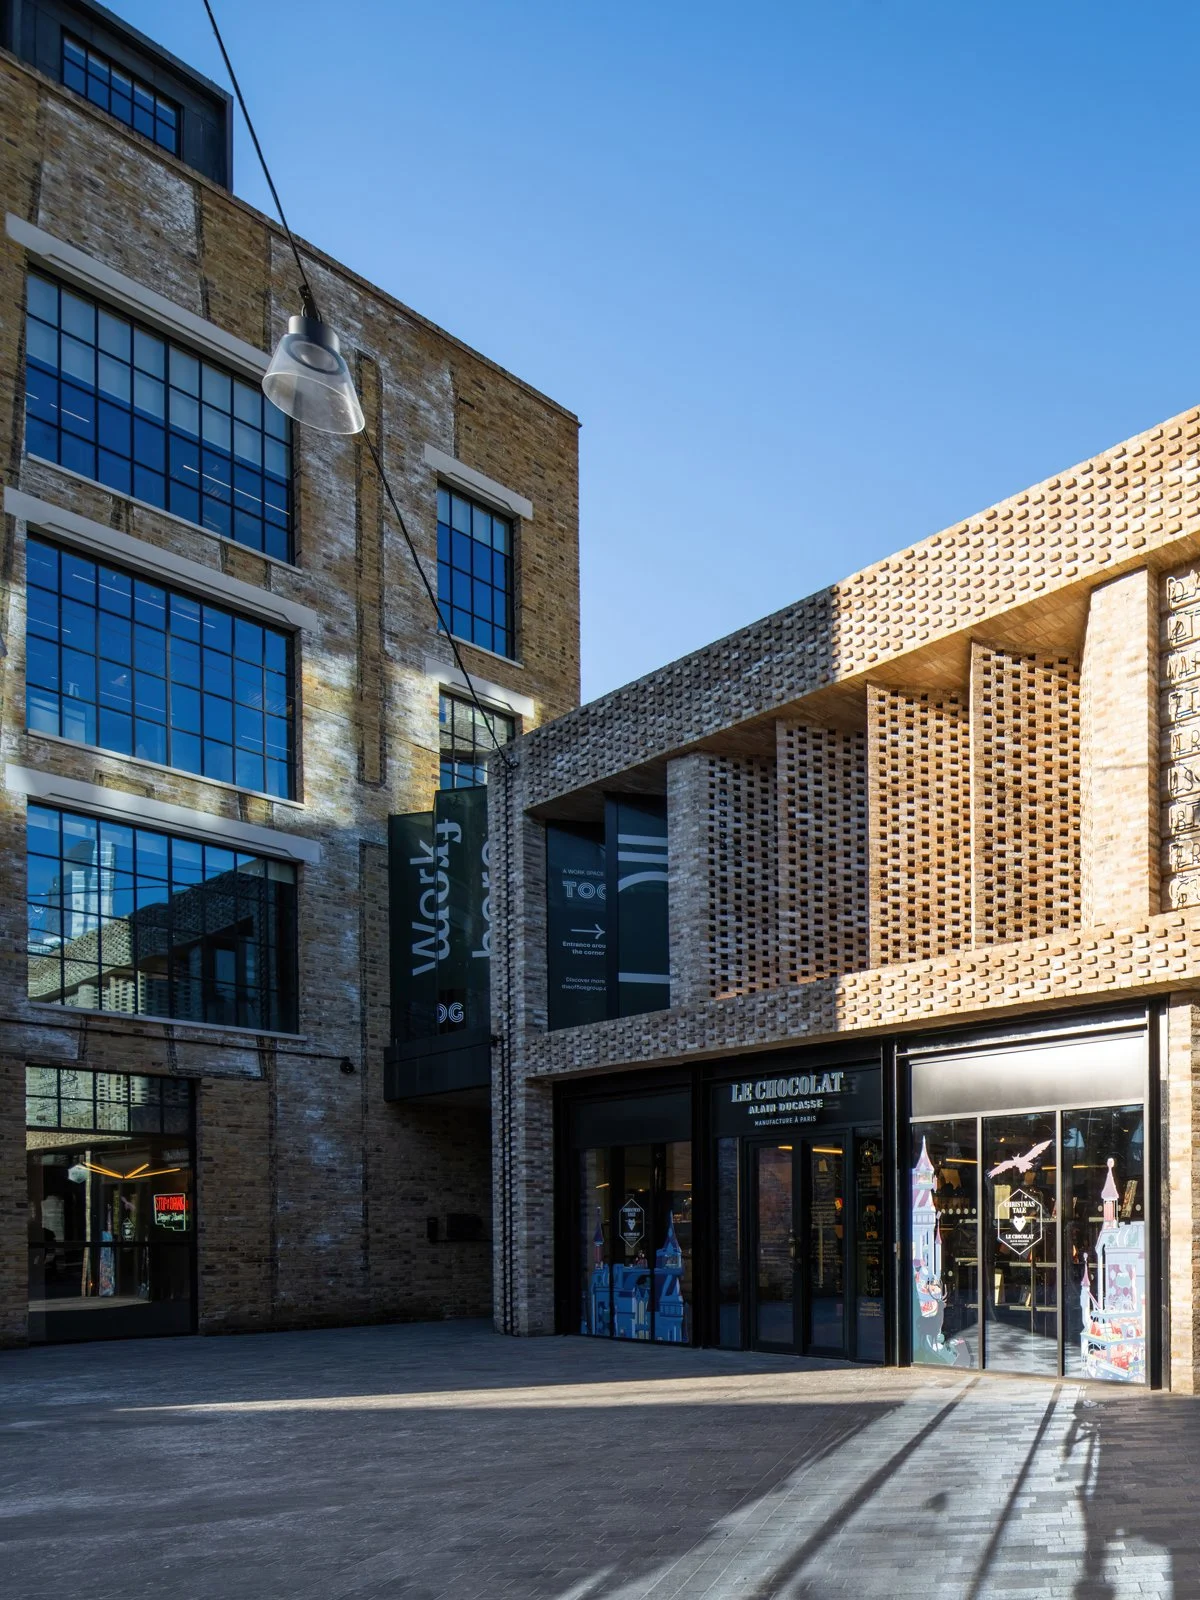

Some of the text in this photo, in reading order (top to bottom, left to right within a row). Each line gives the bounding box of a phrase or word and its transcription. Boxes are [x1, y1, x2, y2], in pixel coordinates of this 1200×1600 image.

[731, 1072, 844, 1103] LE CHOCOLAT
[748, 1099, 823, 1114] ALAIN DUCASSE
[754, 1118, 793, 1126] MANUFACTURE
